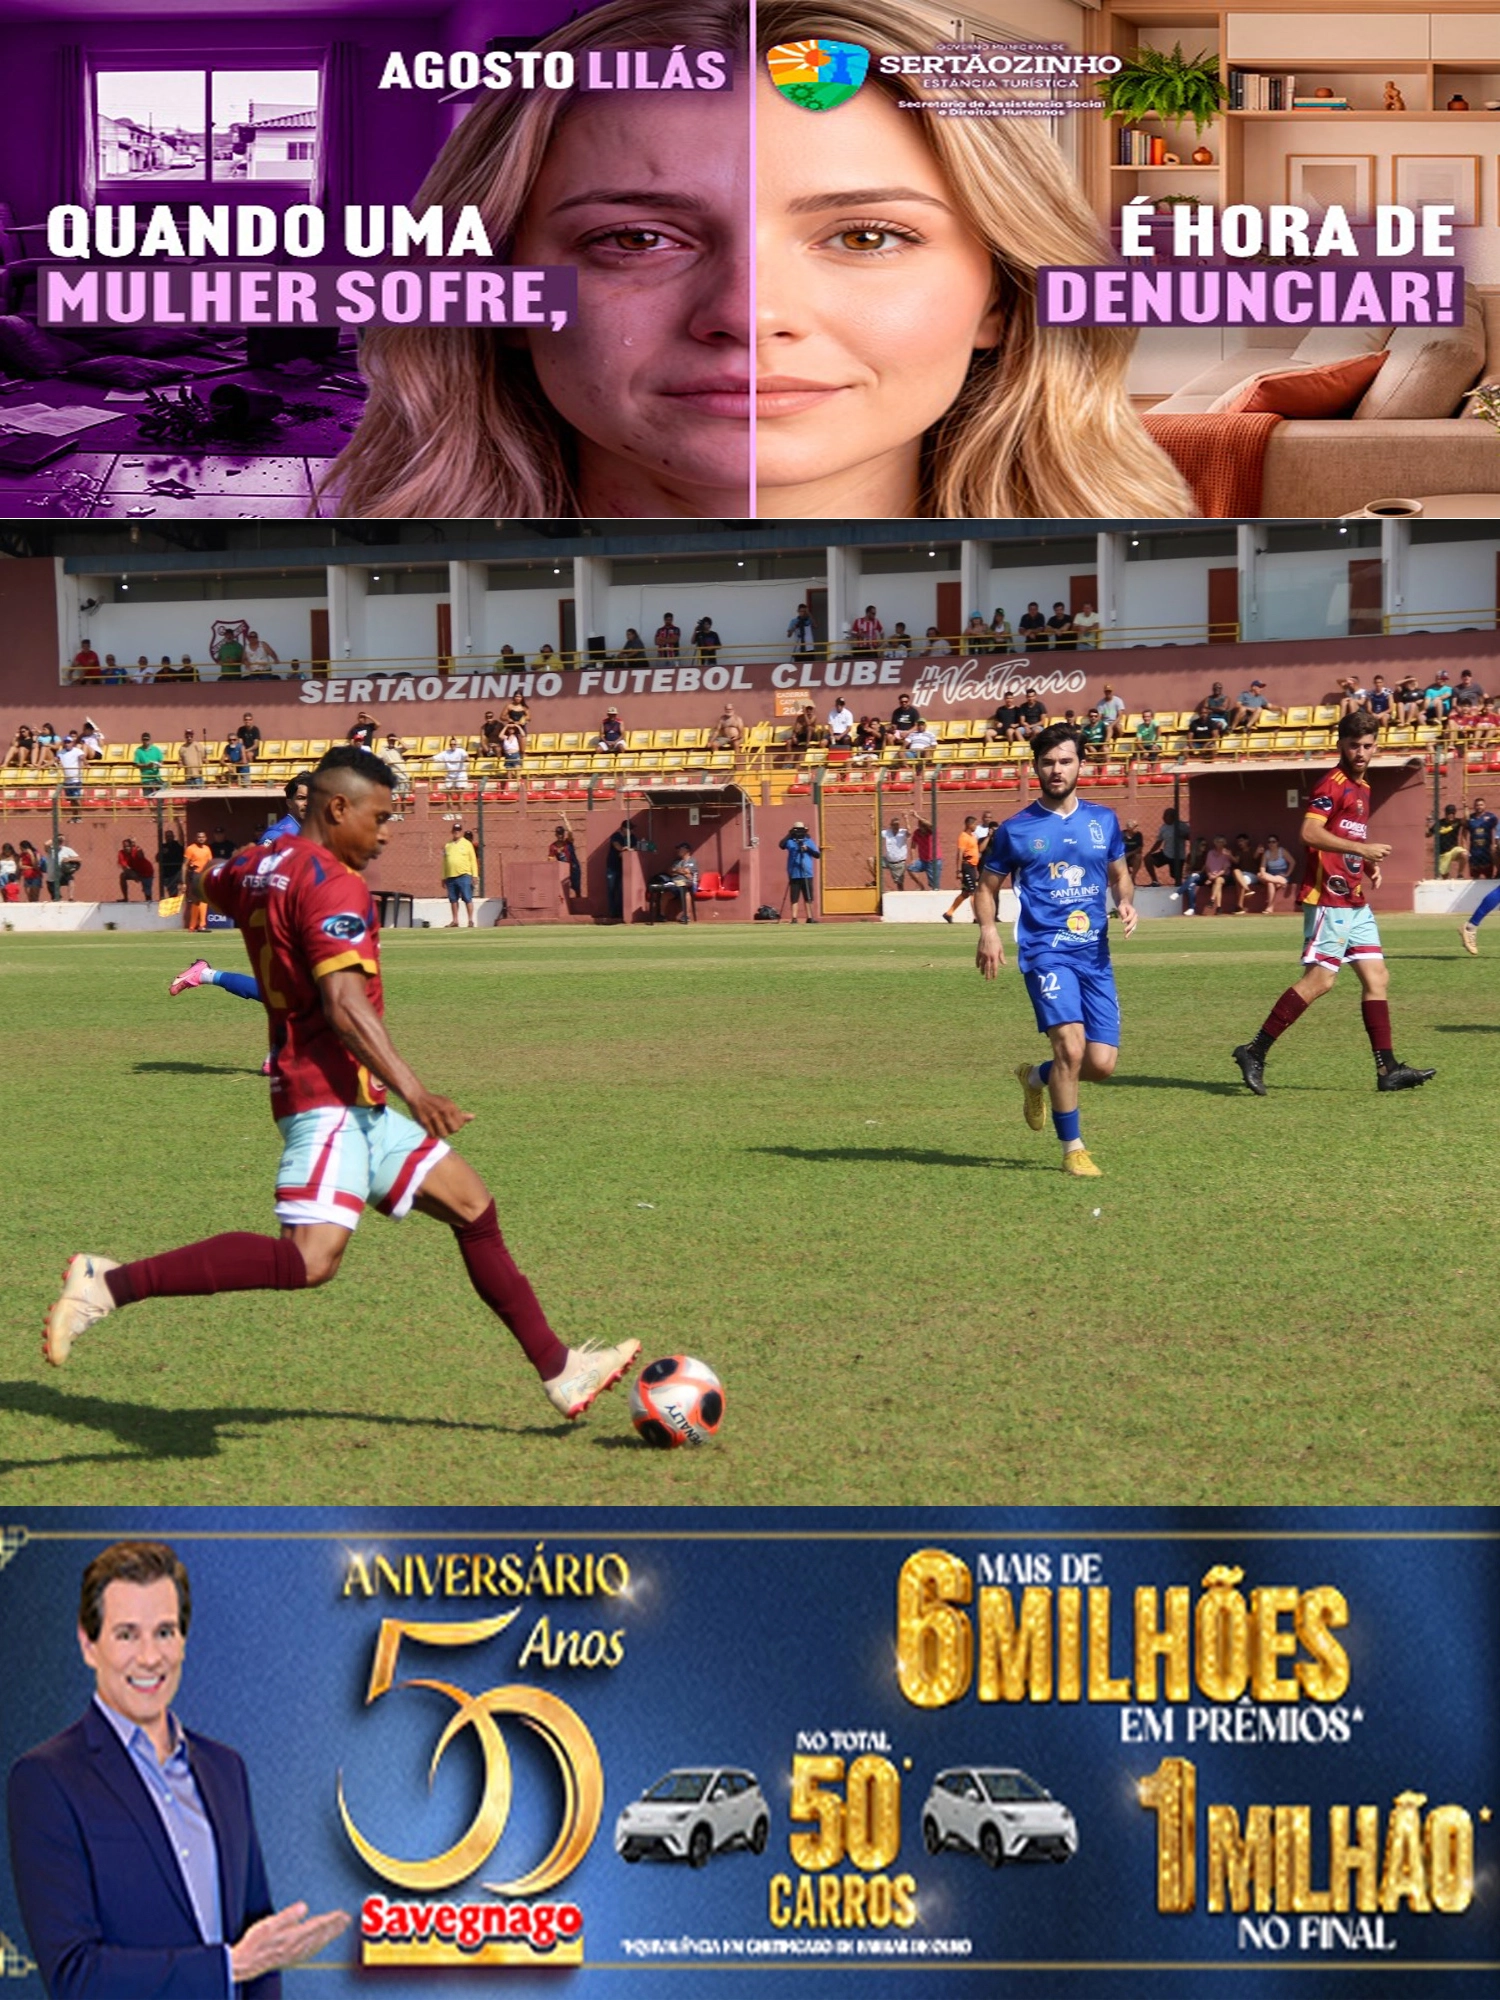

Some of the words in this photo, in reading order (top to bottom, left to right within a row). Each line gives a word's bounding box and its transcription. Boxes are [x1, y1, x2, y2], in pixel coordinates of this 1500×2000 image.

[299, 671, 563, 704] SERTÃOZINHO
[578, 664, 753, 696] FUTEBOL
[771, 658, 904, 690] CLUBE
[1050, 886, 1080, 899] SANTA
[1081, 883, 1100, 896] INÊS
[1038, 972, 1061, 993] 22
